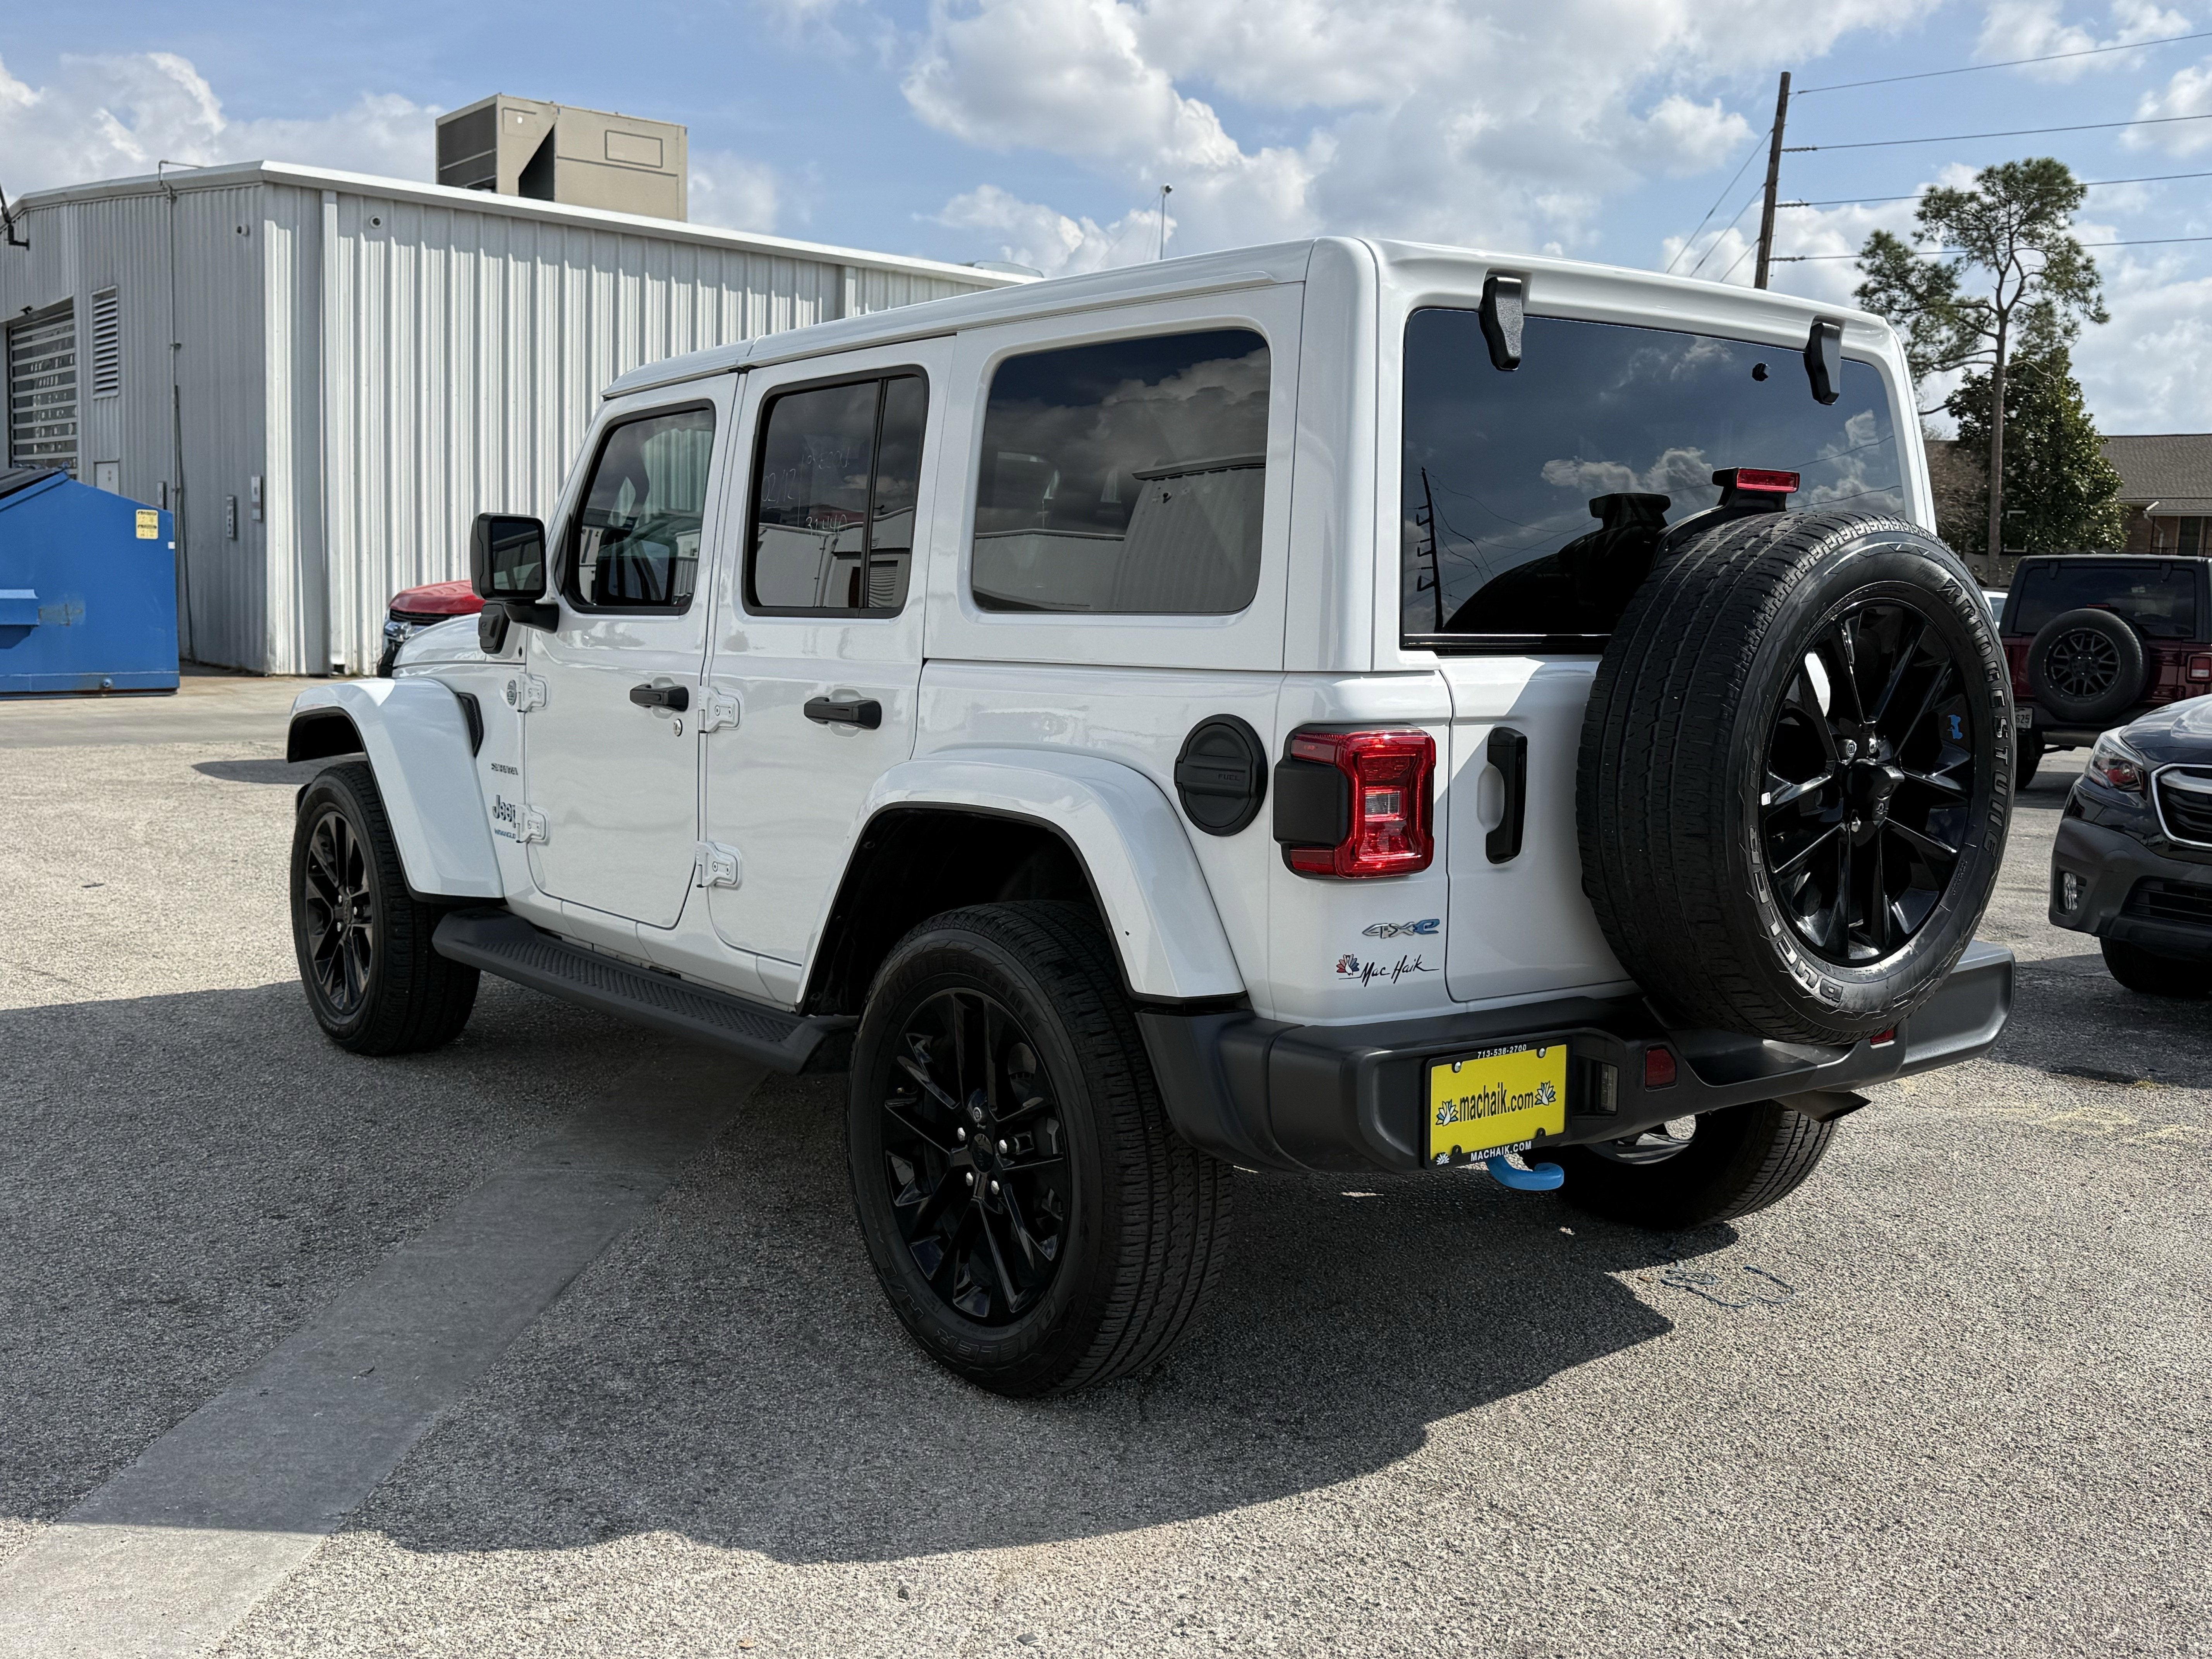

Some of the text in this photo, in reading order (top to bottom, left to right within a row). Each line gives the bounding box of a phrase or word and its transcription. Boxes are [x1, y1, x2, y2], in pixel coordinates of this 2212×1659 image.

[1359, 954, 1439, 987] Mac Haik
[1460, 1082, 1534, 1122] machaik.com
[1470, 1140, 1532, 1161] MACHAIK.COM
